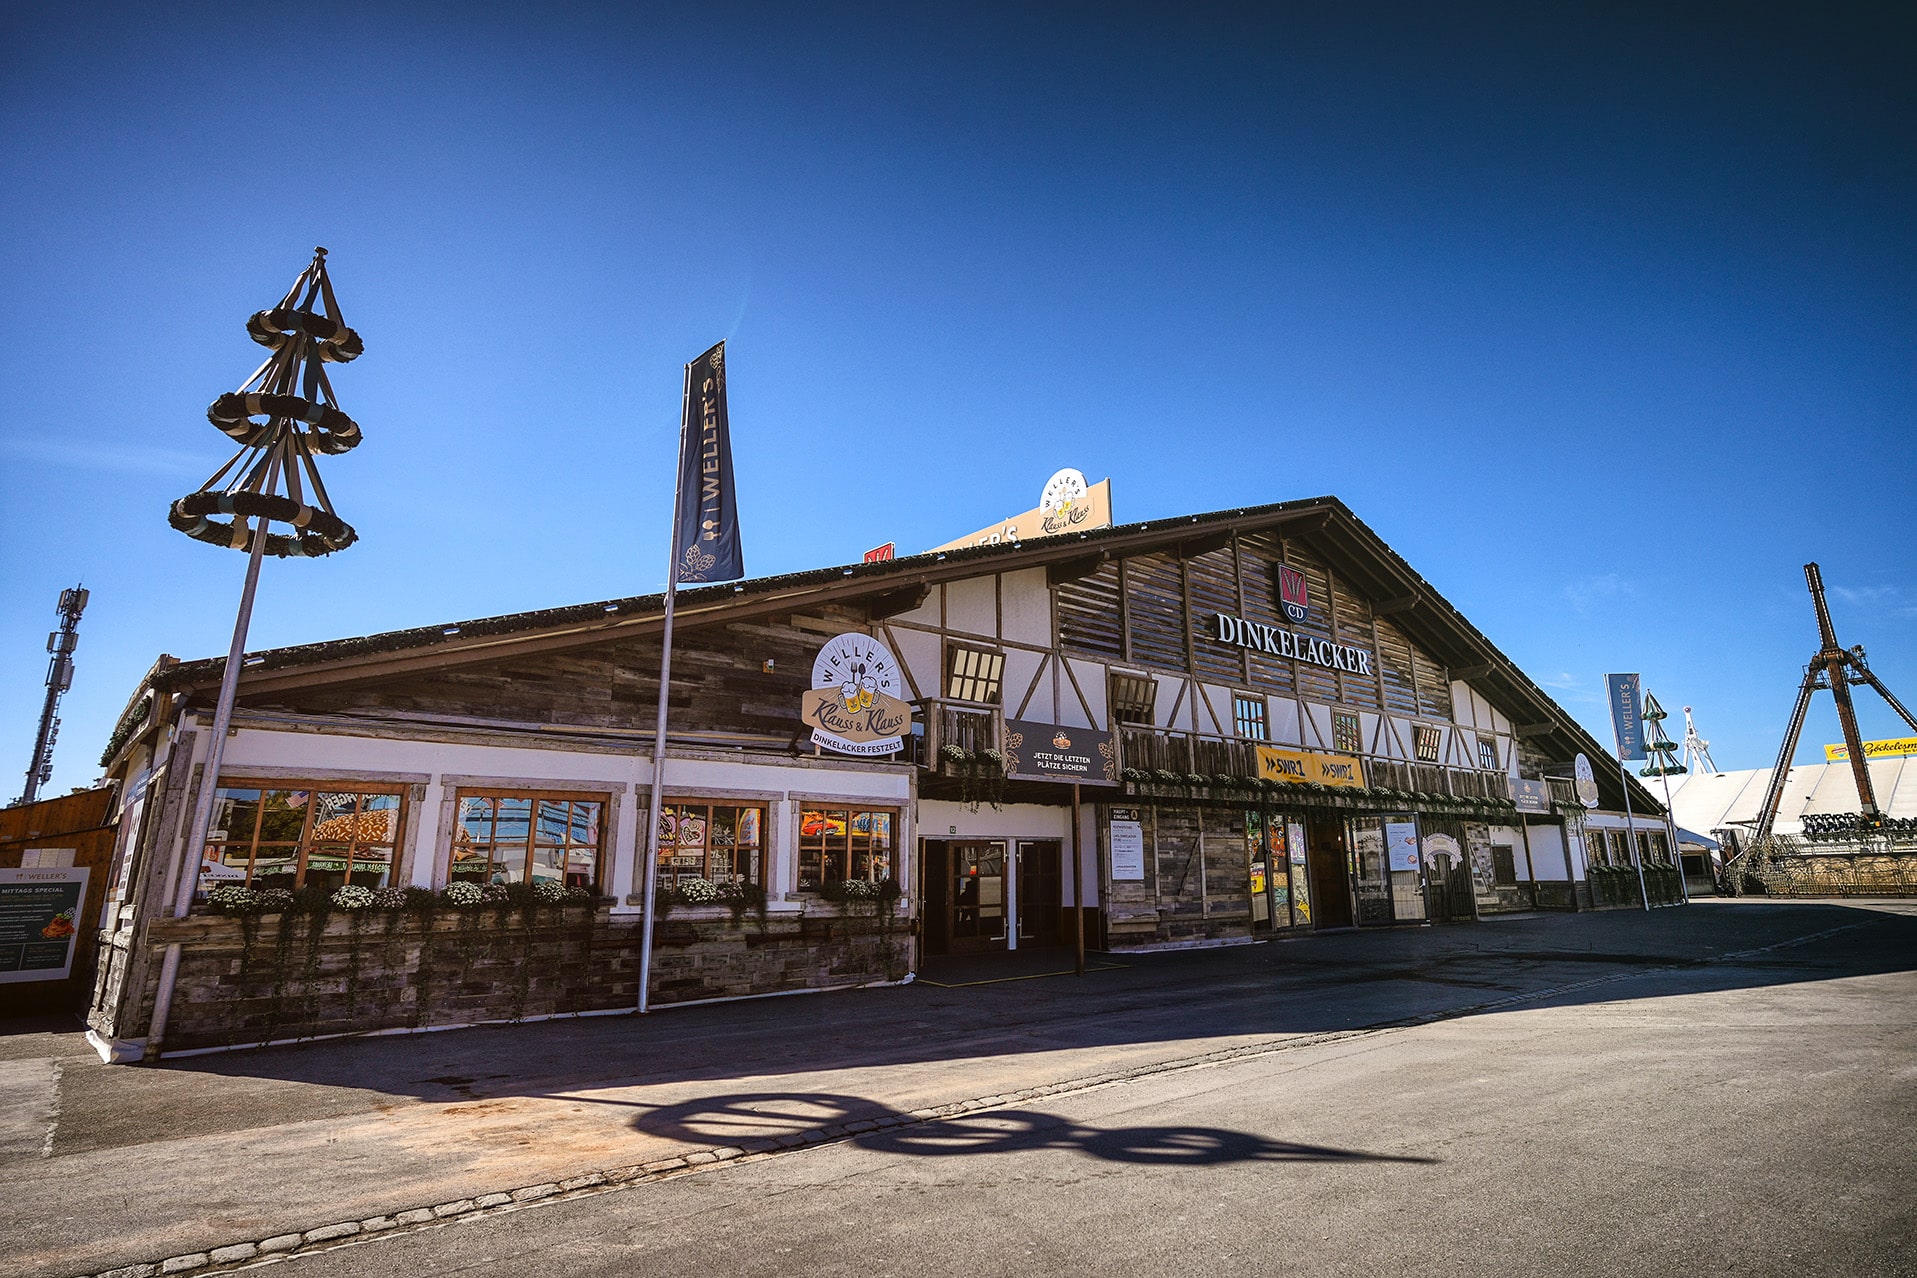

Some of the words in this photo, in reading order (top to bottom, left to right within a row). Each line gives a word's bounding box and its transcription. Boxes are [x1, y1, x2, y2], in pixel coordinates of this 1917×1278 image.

[702, 376, 722, 502] WELLER'S
[1045, 476, 1081, 508] WELLER'S
[1287, 603, 1304, 619] CD
[1216, 612, 1372, 676] DINKELACKER
[823, 646, 891, 688] WELLER'S
[811, 697, 854, 734] Klauss
[855, 721, 863, 732] &
[864, 709, 904, 736] Klauss
[1620, 683, 1634, 731] WELLER'S
[813, 733, 866, 754] DINKELACKER
[867, 741, 901, 754] FESTZELT
[1033, 751, 1052, 760] JETZT
[1054, 753, 1064, 762] DIE
[1064, 755, 1091, 764] LETZTEN
[1037, 760, 1061, 770] PLÄTZE
[1062, 763, 1088, 772] SICHERN
[1276, 758, 1306, 777] SWR1
[1330, 763, 1354, 781] SWR1
[28, 872, 68, 880] WELLER'S
